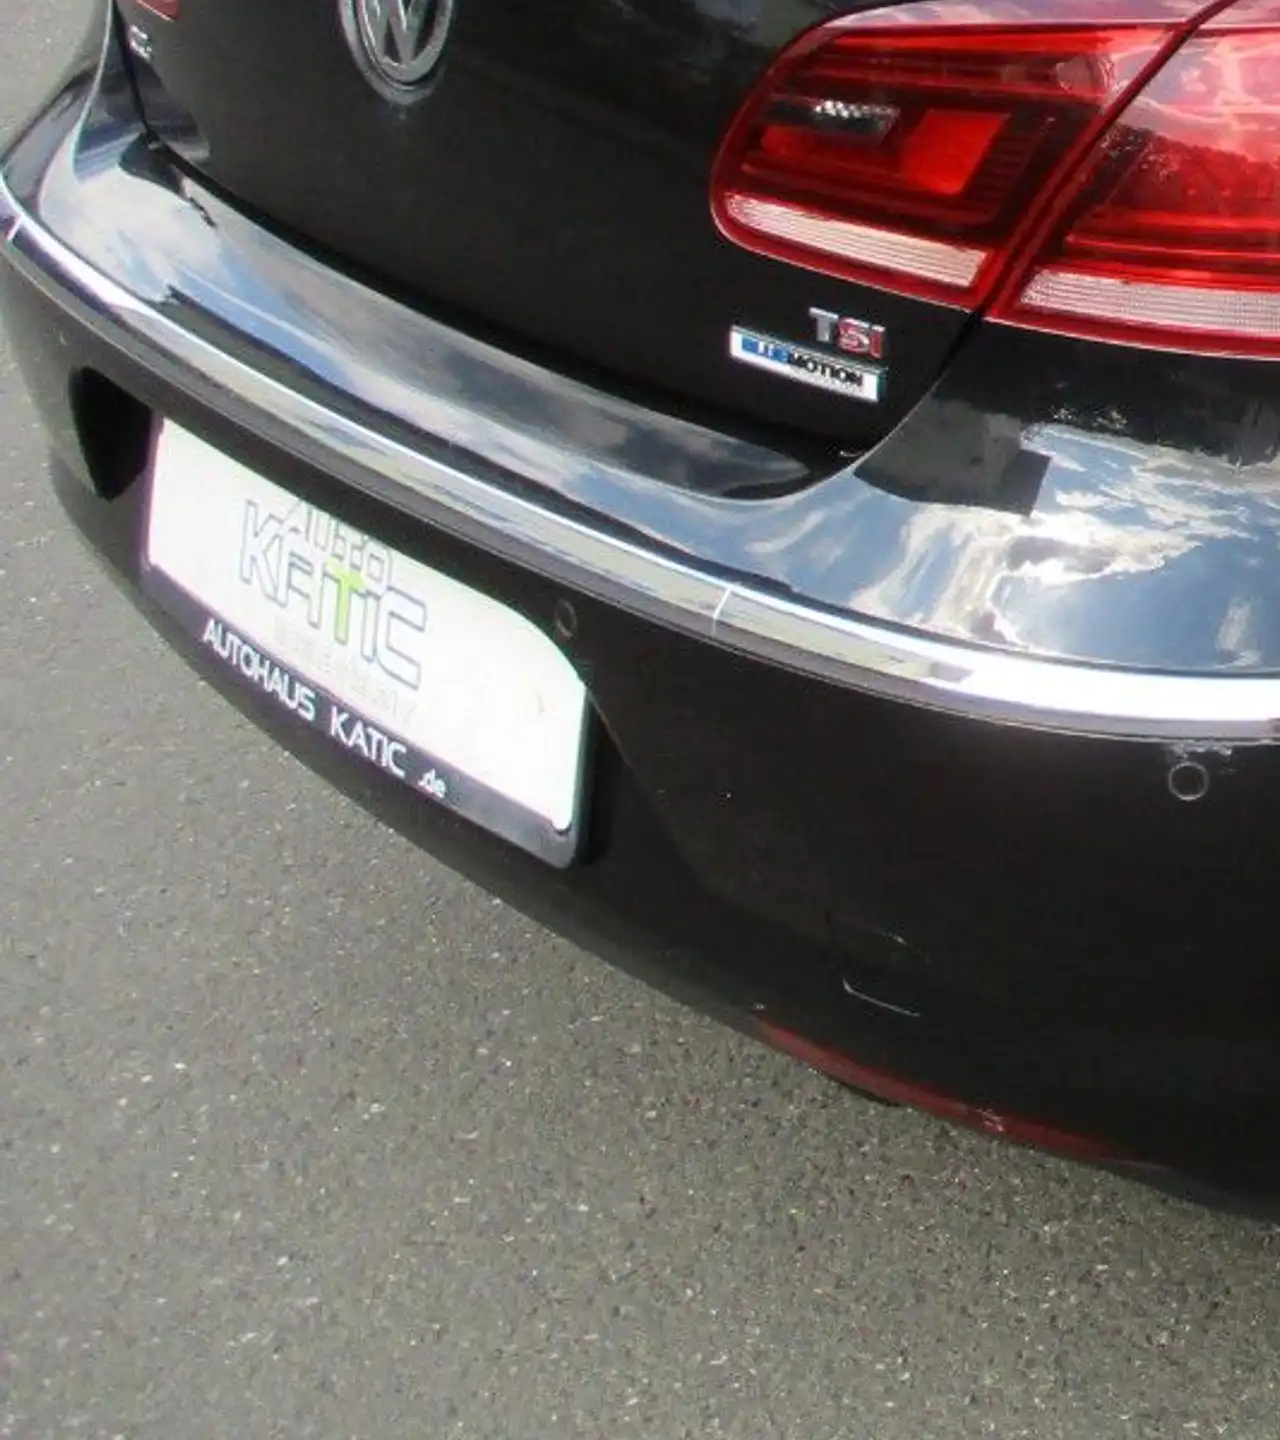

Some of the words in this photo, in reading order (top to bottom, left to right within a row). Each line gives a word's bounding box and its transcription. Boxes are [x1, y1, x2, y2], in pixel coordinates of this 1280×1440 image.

[742, 333, 863, 387] MOTION
[809, 307, 886, 359] TSI
[239, 499, 428, 691] KATIC
[203, 617, 316, 722] AUTOHAUS
[330, 705, 407, 779] KATIC
